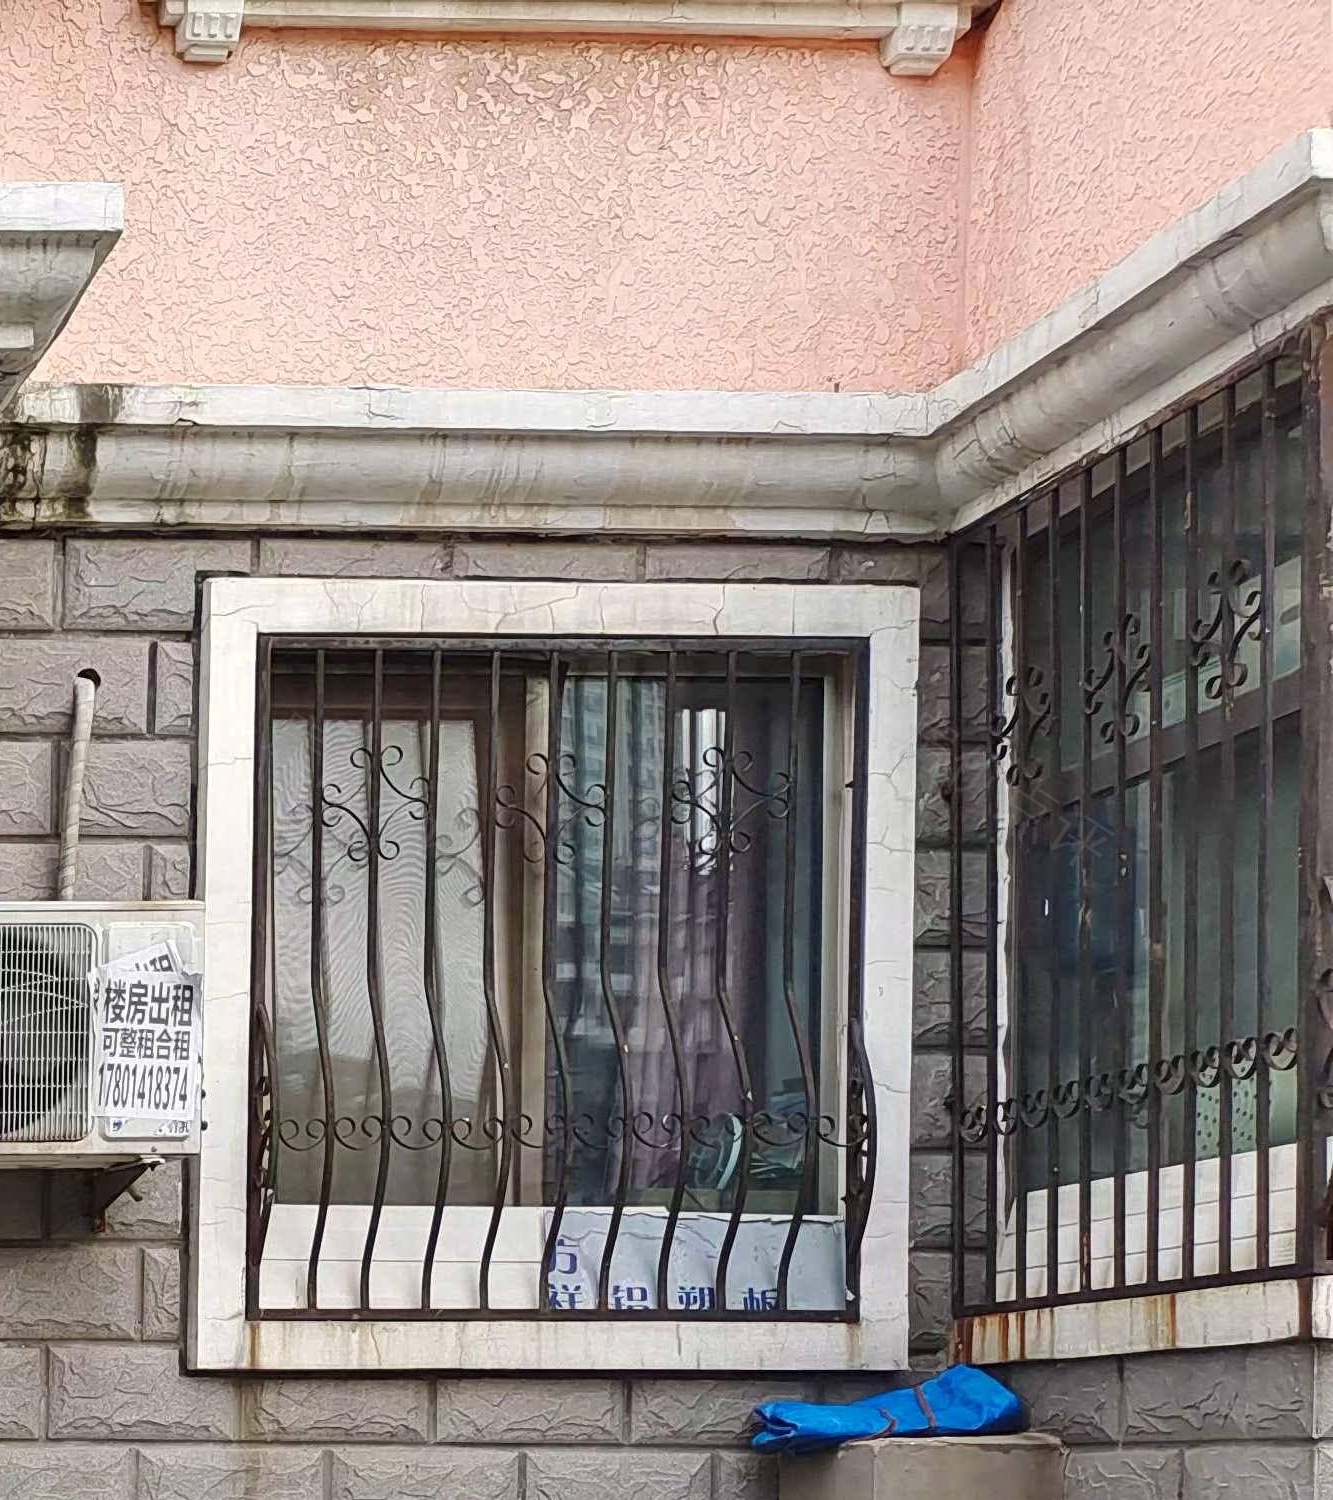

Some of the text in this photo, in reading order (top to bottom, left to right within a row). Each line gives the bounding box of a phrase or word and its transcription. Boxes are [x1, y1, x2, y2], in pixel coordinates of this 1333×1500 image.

[104, 979, 194, 1027] 楼房出租
[102, 1027, 191, 1061] 可整租合租
[98, 1062, 188, 1110] 17801418374
